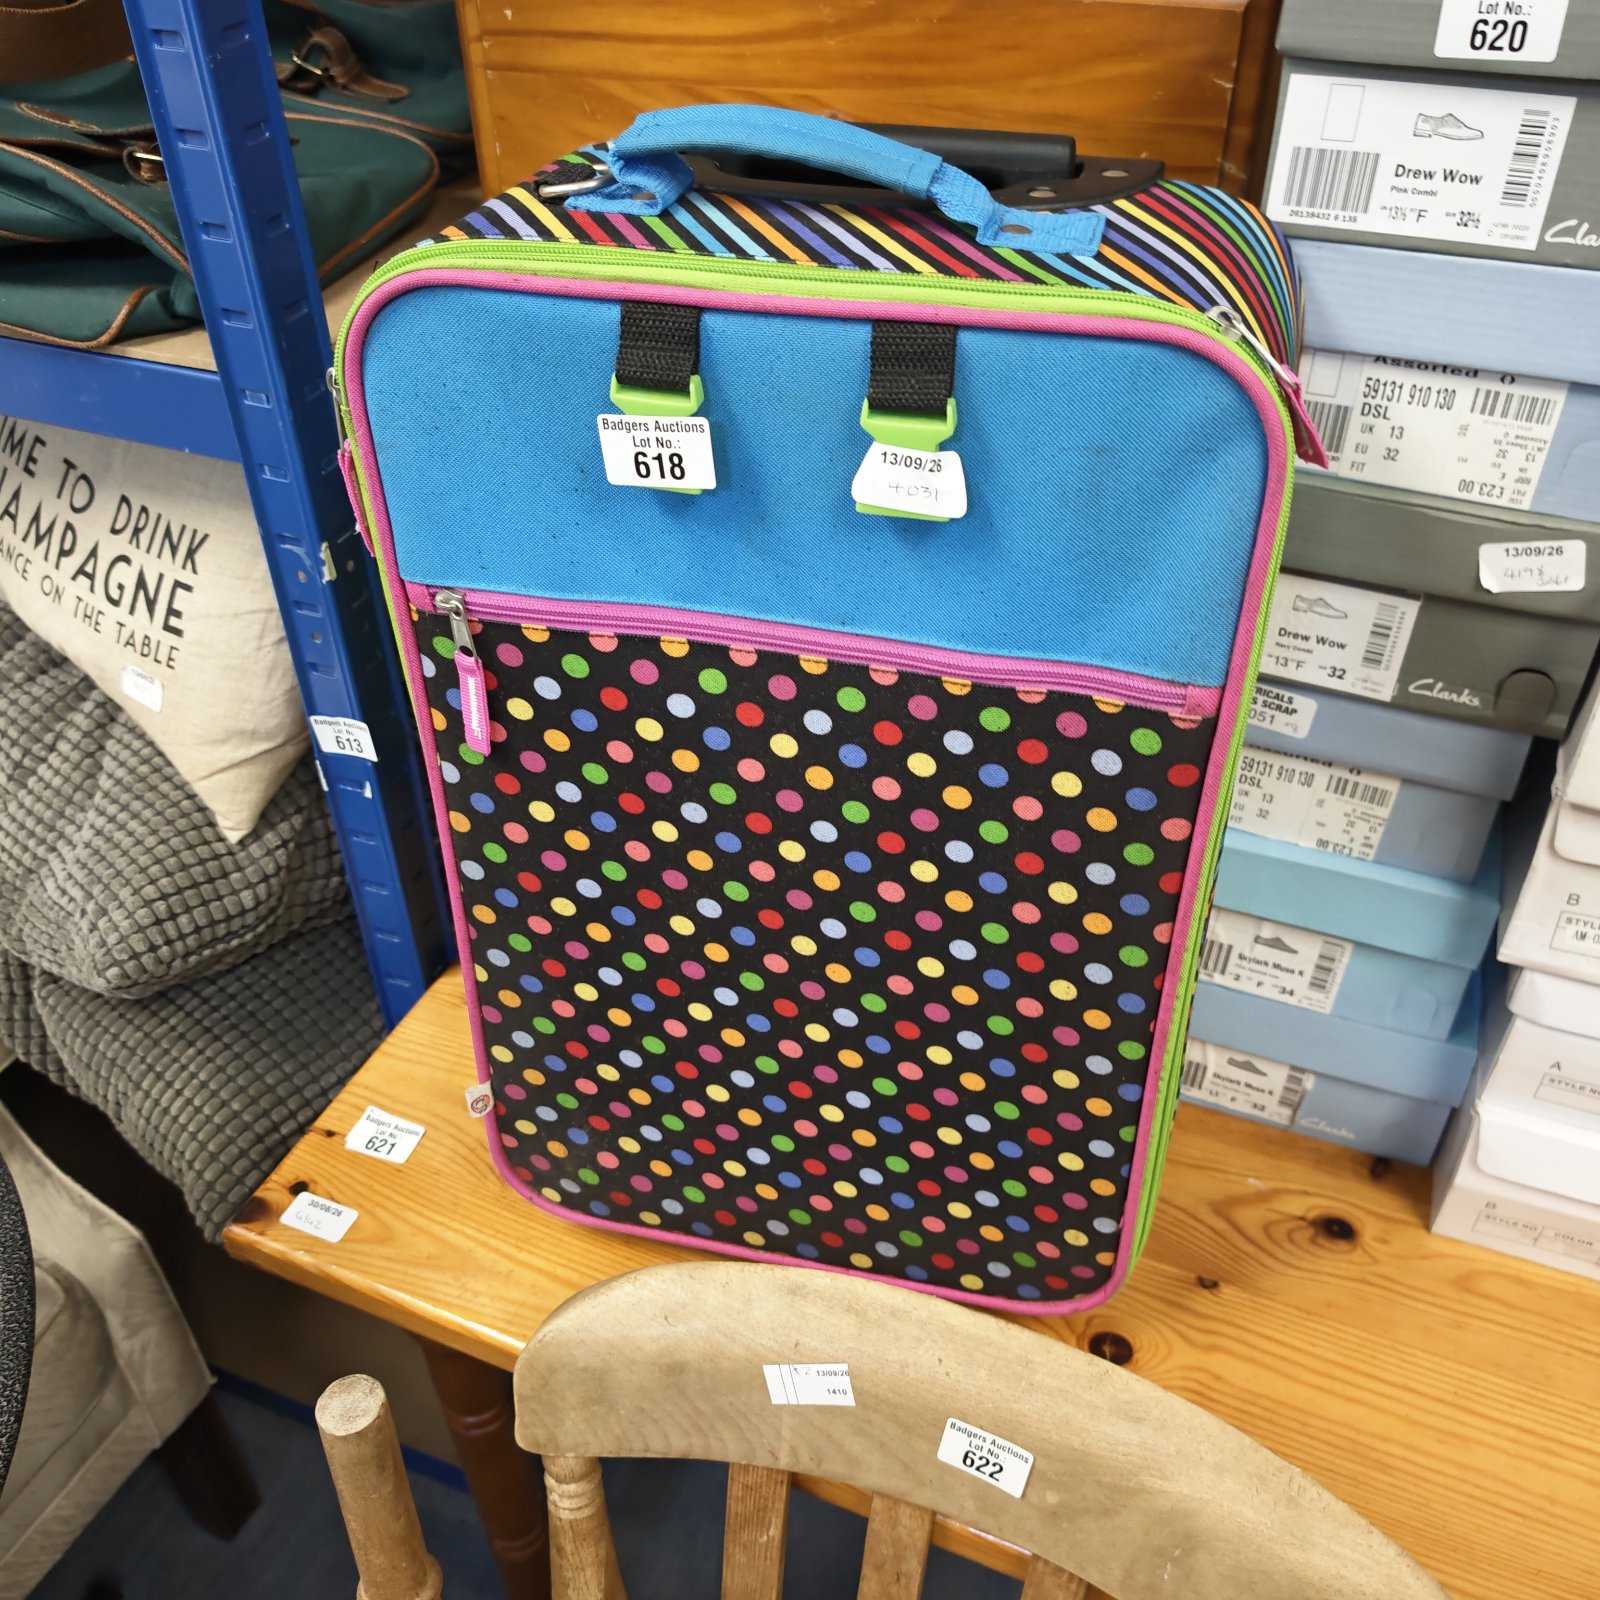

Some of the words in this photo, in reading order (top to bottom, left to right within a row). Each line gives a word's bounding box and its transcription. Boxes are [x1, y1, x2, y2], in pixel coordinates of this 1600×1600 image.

[1478, 0, 1499, 14] Lot
[1470, 18, 1528, 52] 620
[1394, 163, 1437, 182] Drew
[1443, 167, 1483, 187] Wow
[1390, 185, 1408, 195] Pink
[1411, 187, 1438, 197] Combi
[1416, 208, 1428, 223] F
[1544, 218, 1600, 247] Cla
[1374, 354, 1479, 378] Assorted
[1363, 377, 1403, 404] 59131
[1407, 384, 1432, 408] 910
[1434, 387, 1456, 411] 130
[1360, 403, 1391, 421] DSL
[602, 416, 649, 433] Badgers
[654, 419, 705, 434] Auctions
[1361, 423, 1374, 436] UK
[1389, 425, 1404, 440] 13
[632, 435, 651, 449] Lot
[1355, 442, 1368, 455] EU
[1383, 447, 1399, 462] 32
[633, 451, 686, 481] 618
[880, 450, 943, 474] 13/09/26
[1350, 461, 1366, 473] FIT
[1457, 479, 1504, 499] £23.00
[56, 457, 95, 514] TO
[110, 494, 210, 576] DRINK
[1504, 545, 1564, 558] 13/09/26
[41, 575, 65, 606] ON
[74, 595, 103, 635] THE
[115, 620, 181, 670] TABLE
[1278, 627, 1312, 643] Drew
[1316, 635, 1347, 650] Wow
[1274, 655, 1289, 668] 13
[1296, 660, 1306, 671] F
[1327, 666, 1347, 680] 32
[1255, 687, 1294, 705] RICALS
[1407, 678, 1481, 708] Clarks
[1248, 708, 1276, 725] 051
[1261, 699, 1298, 716] SCRAP
[335, 735, 363, 754] 613
[1239, 773, 1263, 789] DSL
[1240, 756, 1274, 778] 59131
[1276, 765, 1295, 784] 910
[1297, 770, 1315, 788] 130
[1262, 792, 1274, 804] 13
[1233, 802, 1245, 811] EU
[1256, 808, 1269, 820] 32
[1566, 892, 1580, 906] B
[1550, 1060, 1561, 1072] A
[365, 1114, 392, 1130] Badgers
[365, 1135, 396, 1156] 621
[308, 1199, 344, 1217] 30/08/26
[950, 1420, 987, 1444] Badgers
[989, 1436, 1030, 1465] Auctions
[968, 1439, 985, 1453] Lot
[962, 1449, 1005, 1482] 622
